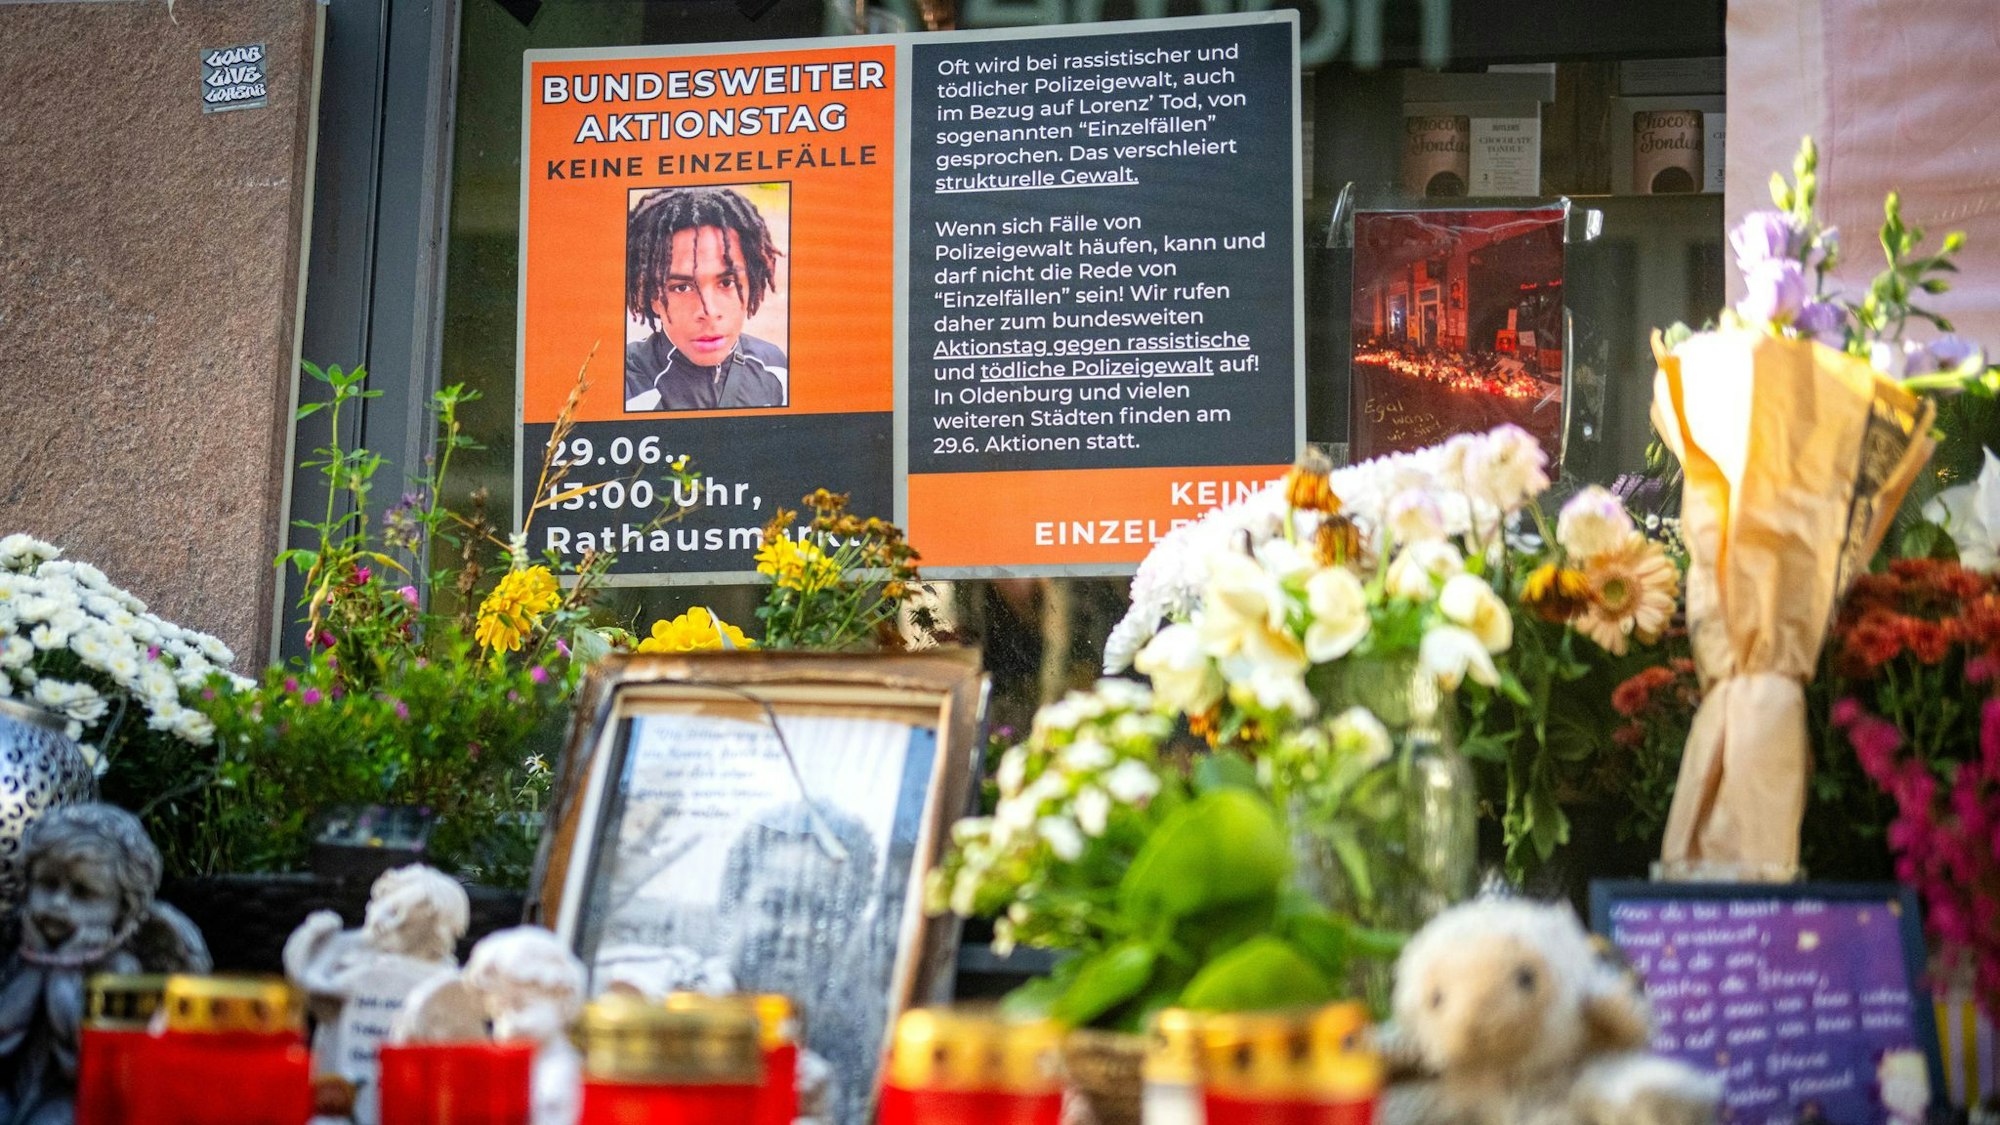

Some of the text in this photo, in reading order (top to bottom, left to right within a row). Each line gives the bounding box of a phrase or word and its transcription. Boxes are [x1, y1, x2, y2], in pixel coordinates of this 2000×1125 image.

[937, 42, 1239, 76] Oft wird bei rassistischer und
[542, 60, 886, 105] BUNDESWEITER
[936, 67, 1235, 99] tödlicher Polizeigewalt, auch
[937, 105, 963, 122] im
[970, 104, 1034, 121] Bezug
[1040, 98, 1075, 117] auf
[1158, 92, 1202, 111] Tod,
[1207, 93, 1246, 107] von
[574, 103, 848, 144] AKTIONSTAG
[936, 126, 1073, 146] sogenannten
[1479, 136, 1533, 144] CHOCOLATE
[547, 143, 877, 180] KEINE EINZELFÄLLE
[935, 138, 1238, 170] gesprochen. Das verschleiert
[935, 166, 1139, 192] strukturelle Gewalt.
[934, 214, 1142, 237] Wenn sich Fälle von
[935, 231, 1266, 262] Polizeigewalt häufen, kann und
[934, 261, 1177, 285] darf nicht die Rede von
[1075, 285, 1124, 304] sein!
[1129, 283, 1168, 302] Wir
[1173, 282, 1230, 300] rufen
[933, 307, 1204, 333] daher zum bundesweiten
[933, 330, 1250, 358] Aktionstag gegen rassistische
[934, 354, 1259, 381] und tödliche Polizeigewalt auf!
[934, 381, 1190, 406] In Oldenburg und vielen
[932, 405, 1231, 430] weiteren Städten finden am
[1364, 398, 1404, 423] Egal
[933, 433, 1140, 454] 29.6. Aktionen statt.
[545, 476, 763, 511] 13:00 Uhr,
[1171, 479, 1283, 506] KEIN
